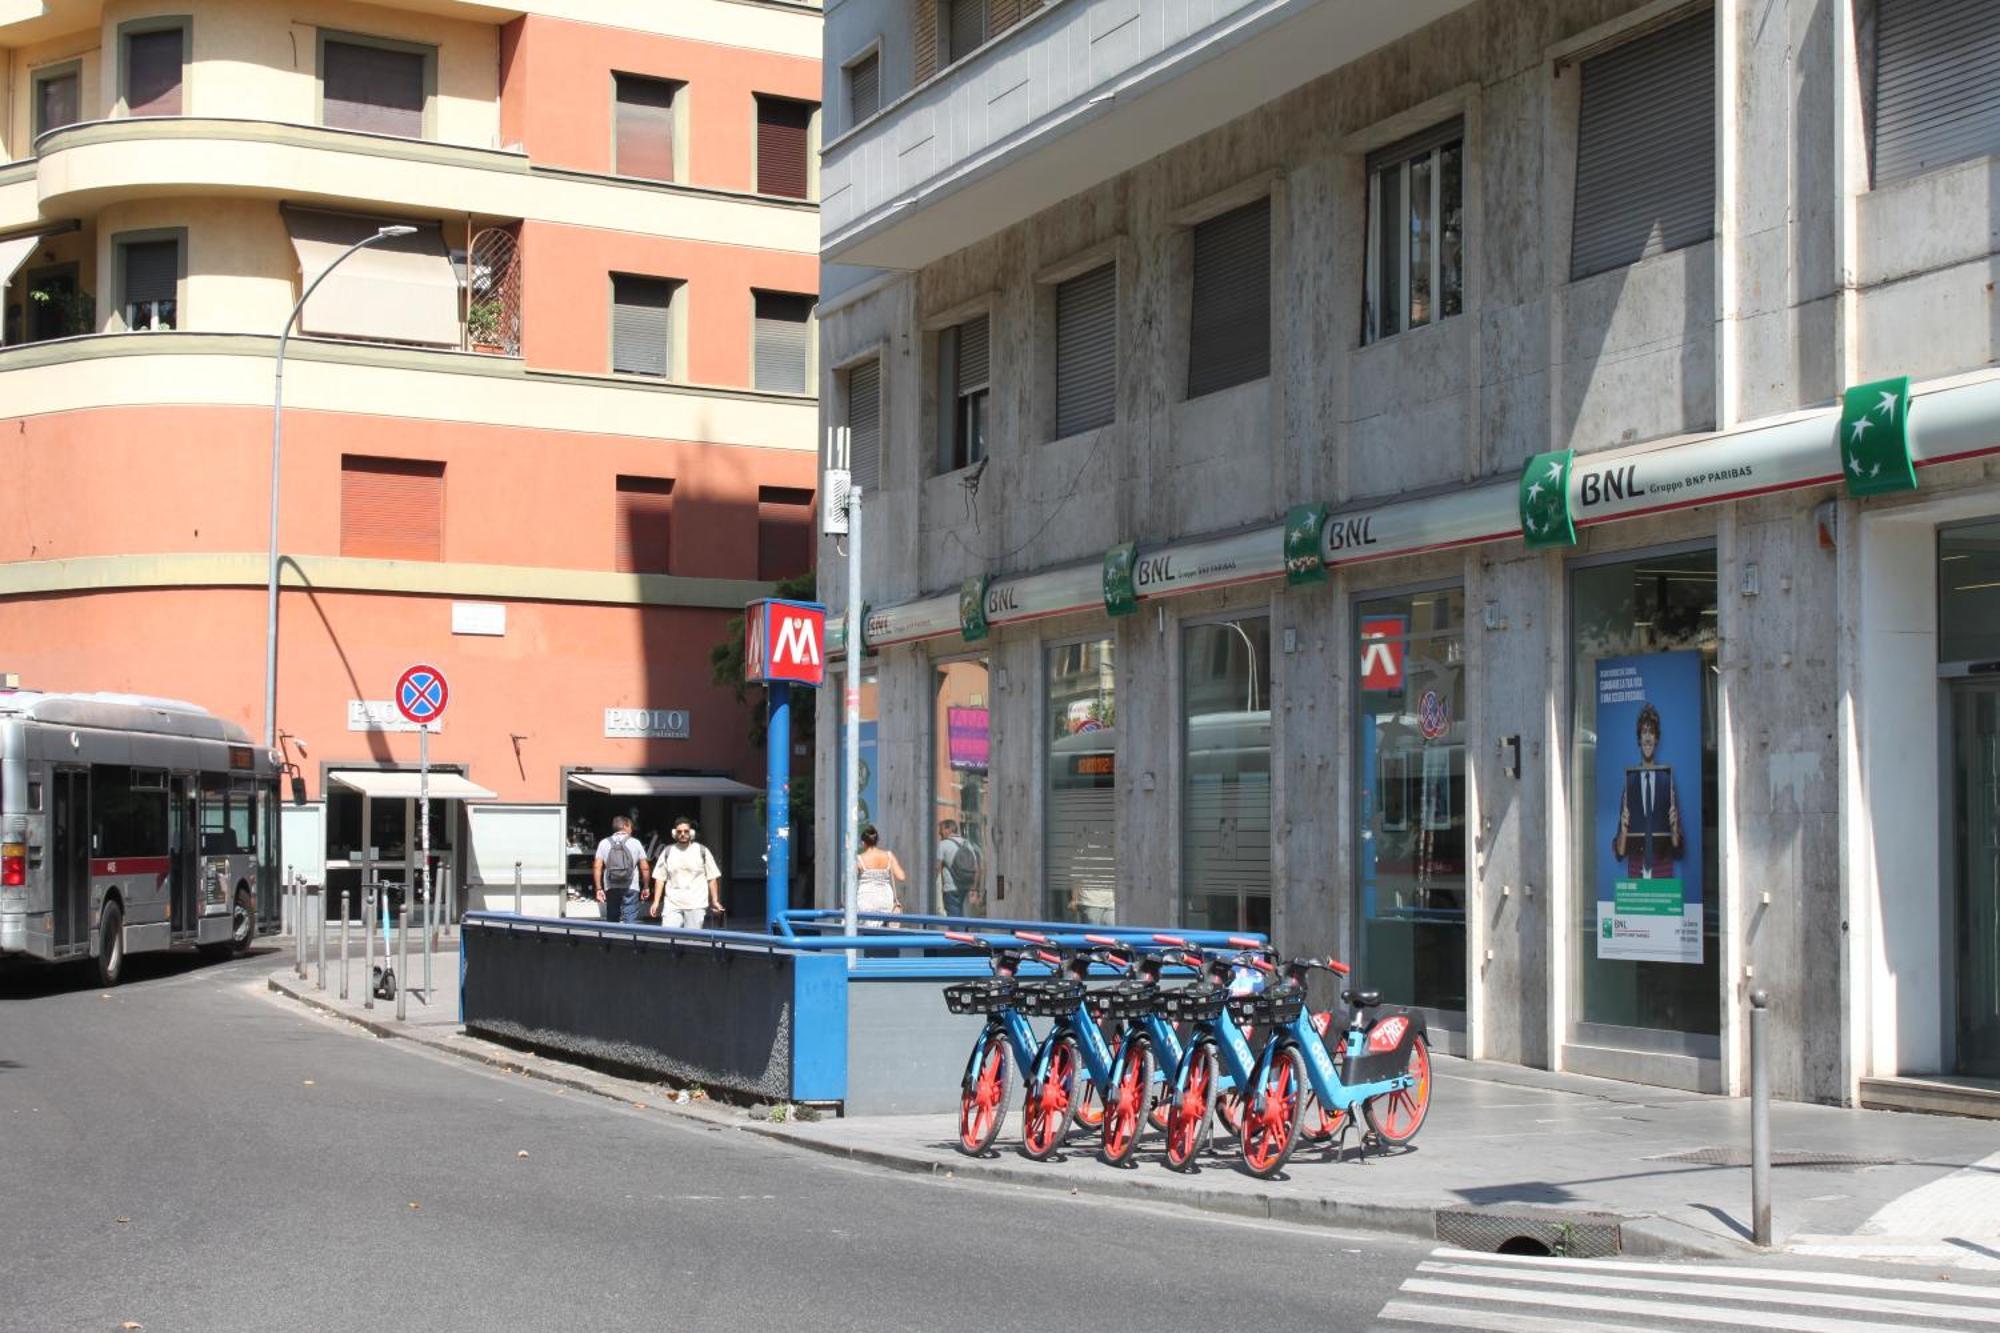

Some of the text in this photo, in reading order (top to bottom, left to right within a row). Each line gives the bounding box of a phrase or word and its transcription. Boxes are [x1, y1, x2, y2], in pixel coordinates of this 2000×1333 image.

[1580, 464, 1753, 507] BNL Gruppo BNP PARIBAS
[1329, 515, 1377, 551] BNL
[1138, 555, 1176, 586] BNL
[988, 587, 1019, 614] BNL
[772, 616, 820, 666] M
[607, 710, 683, 730] PAOLO
